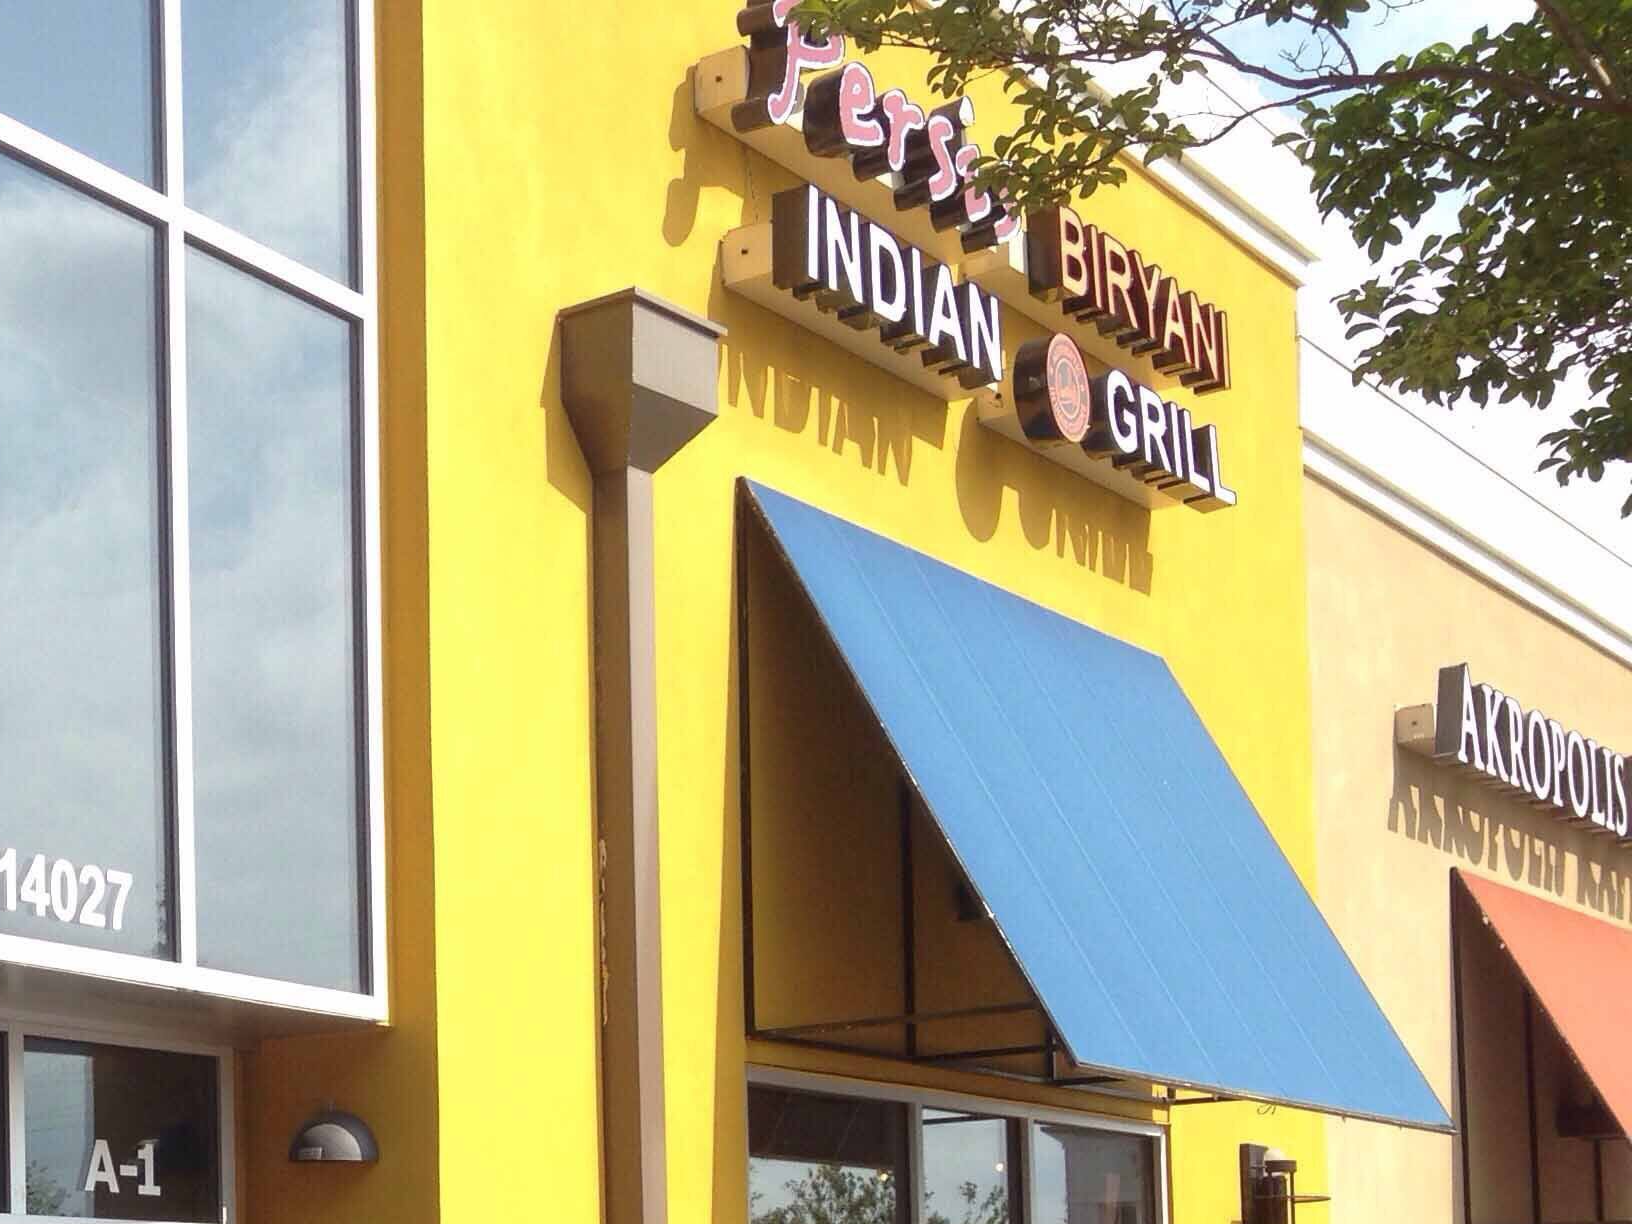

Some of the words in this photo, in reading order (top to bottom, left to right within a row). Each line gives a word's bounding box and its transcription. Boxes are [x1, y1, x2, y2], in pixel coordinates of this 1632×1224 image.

[807, 183, 1003, 382] INDIAN
[1058, 205, 1231, 390] BIRYANI
[1106, 368, 1237, 506] GRILL
[1457, 662, 1628, 837] AKROPOLIS
[84, 1139, 161, 1197] A-1
